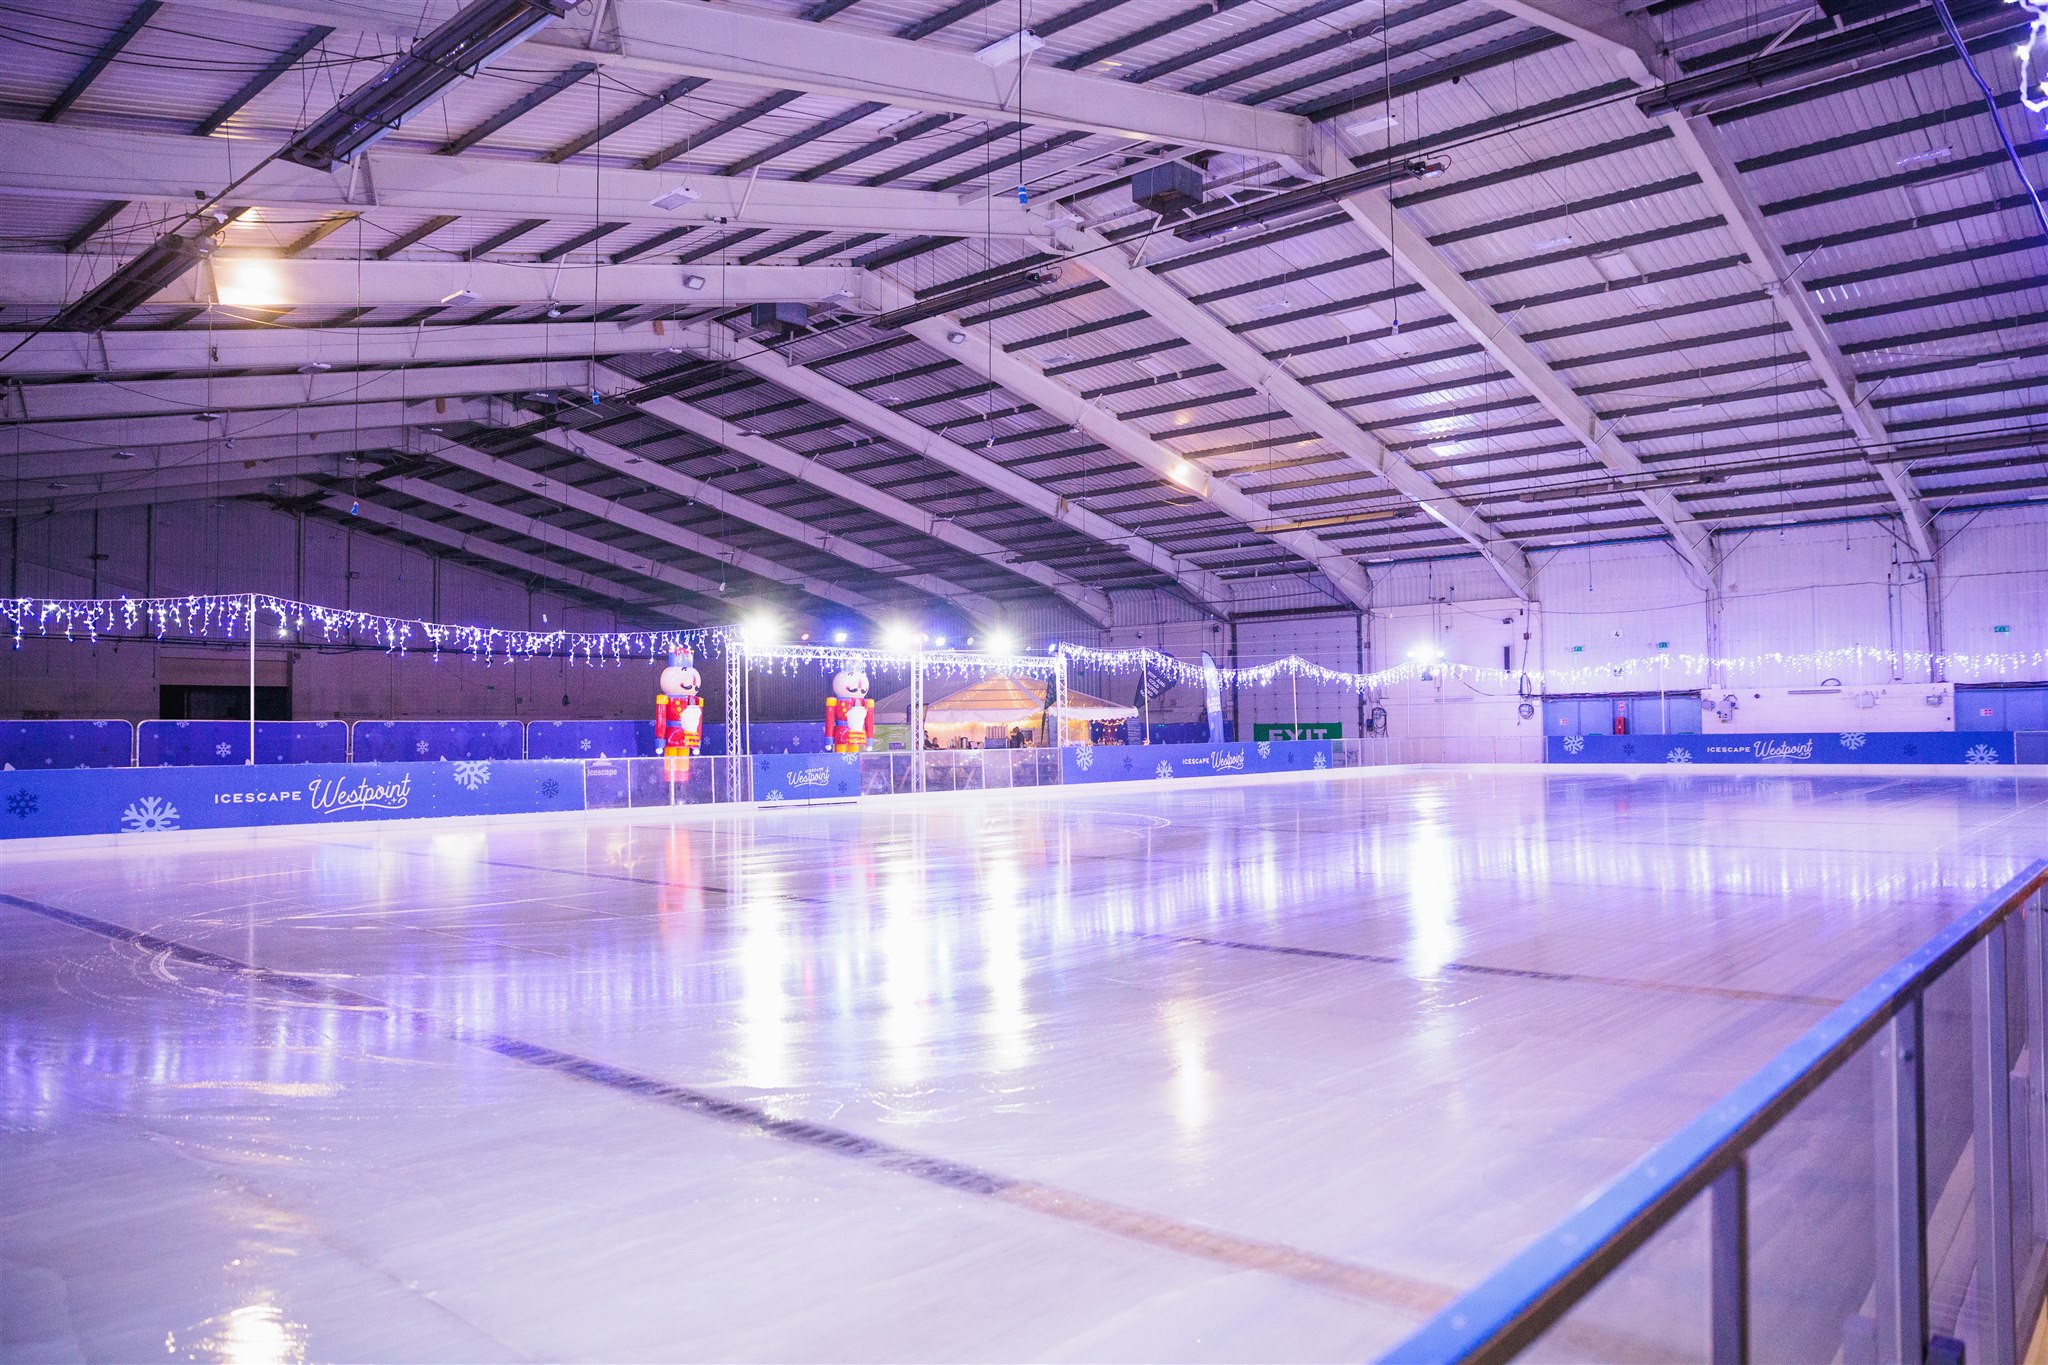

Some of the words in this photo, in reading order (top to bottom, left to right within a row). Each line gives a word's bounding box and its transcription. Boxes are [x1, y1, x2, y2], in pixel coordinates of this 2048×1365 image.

[1148, 678, 1160, 689] COLD
[1268, 729, 1328, 741] EXIT
[1182, 757, 1210, 765] ICESCAPE
[1210, 748, 1245, 771] Westpoint
[1753, 738, 1813, 760] Westpoint
[587, 769, 618, 777] Icescape
[787, 766, 830, 788] Westpoint
[214, 791, 302, 804] ICESCAPE
[308, 772, 411, 814] Westpoint
